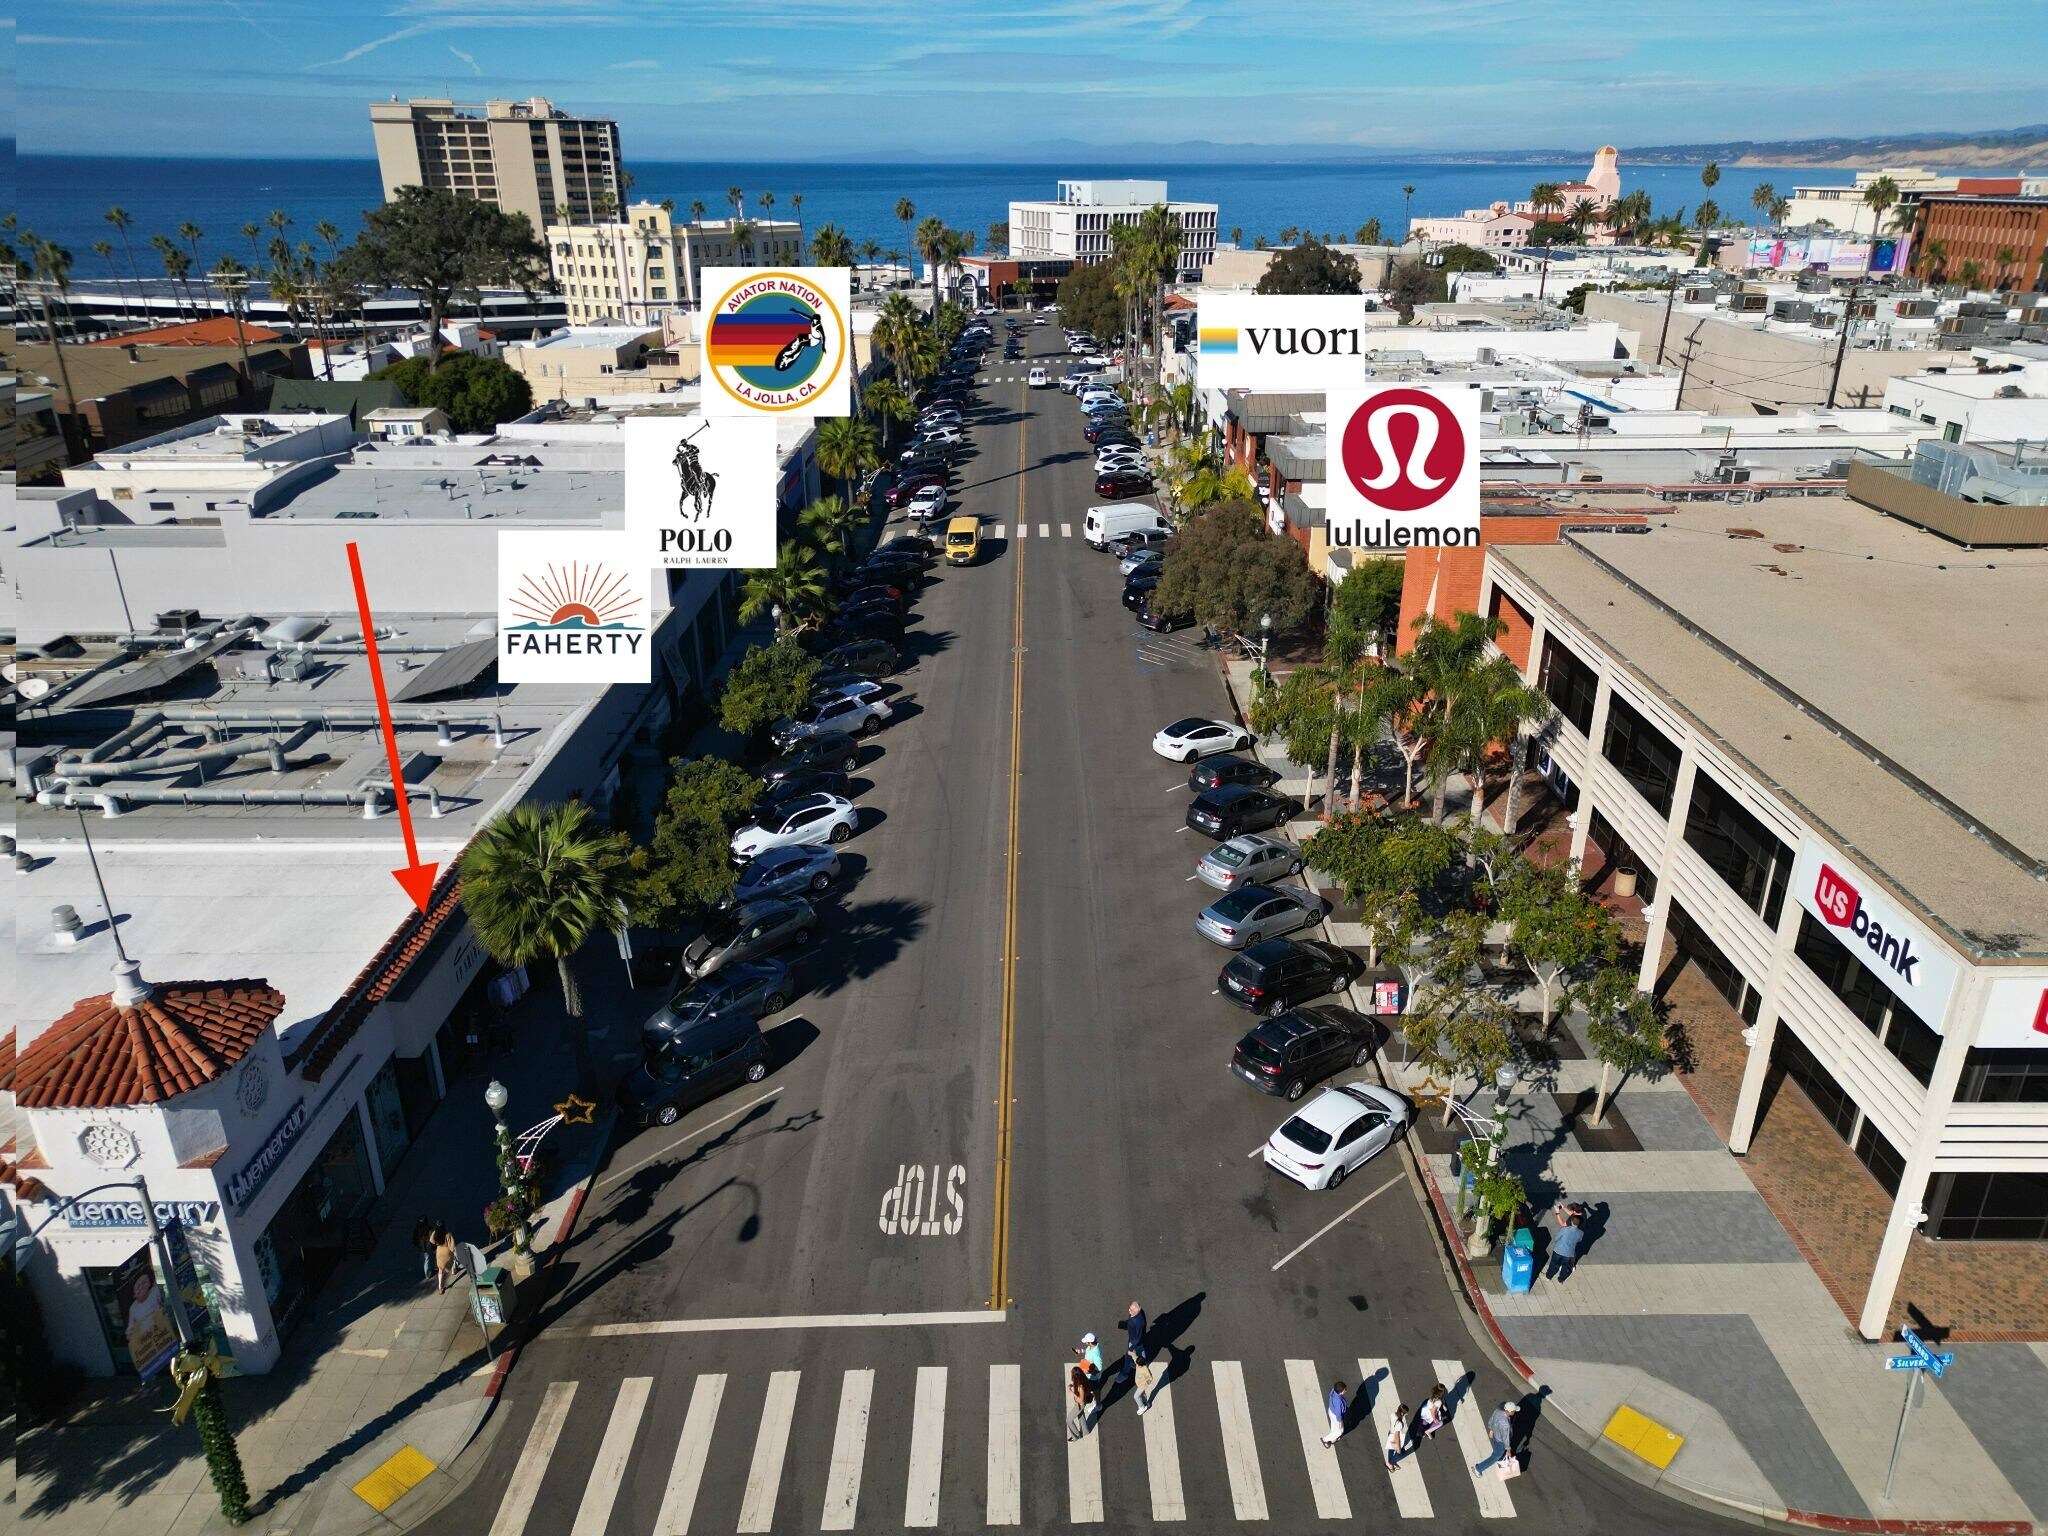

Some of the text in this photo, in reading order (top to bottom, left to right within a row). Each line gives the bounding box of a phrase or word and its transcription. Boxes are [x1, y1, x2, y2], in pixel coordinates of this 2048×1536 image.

[228, 1103, 308, 1205] bluemercury
[43, 1198, 212, 1225] bluemecury
[879, 1164, 966, 1235] STOP
[1908, 1334, 1929, 1361] GIRARD
